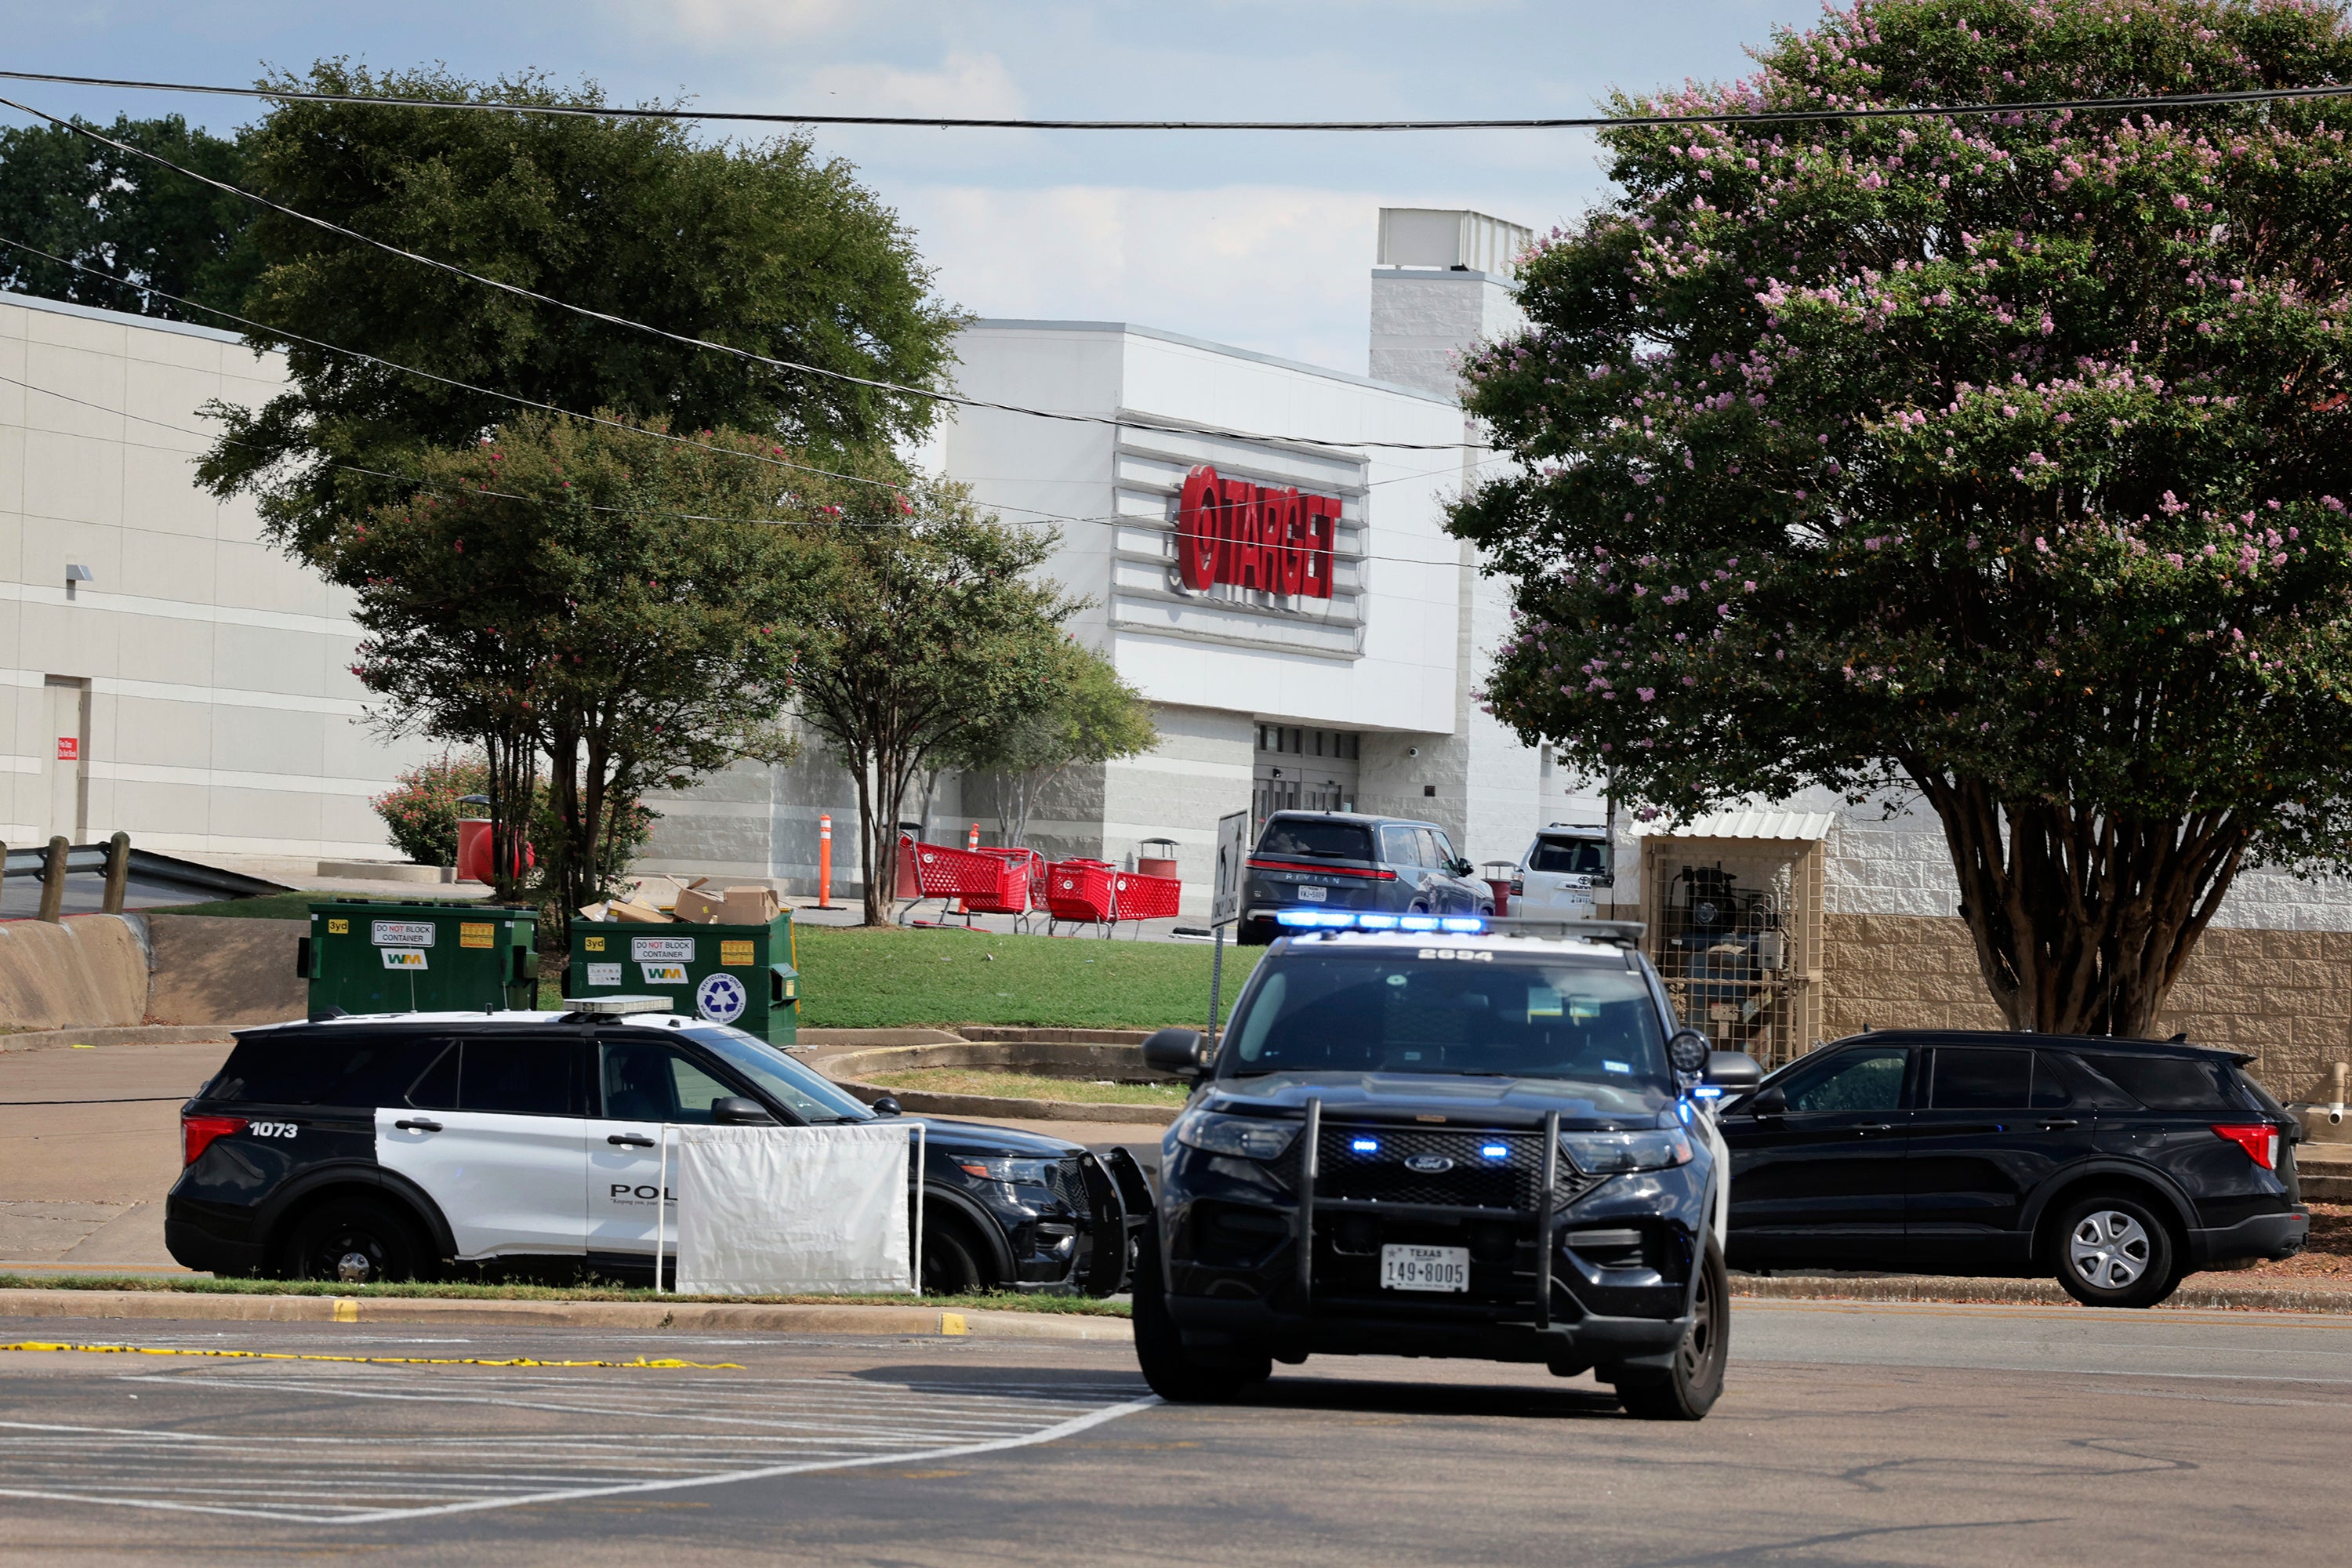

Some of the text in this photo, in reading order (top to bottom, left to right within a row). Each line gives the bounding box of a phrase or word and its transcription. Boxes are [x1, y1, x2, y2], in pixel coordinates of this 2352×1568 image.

[1220, 478, 1342, 599] TARGET
[1285, 873, 1341, 884] RIVIAN
[329, 921, 348, 931] 3yd
[586, 939, 604, 949] 3yd
[387, 953, 423, 964] WM
[1417, 948, 1494, 962] 2694
[648, 968, 682, 979] WM
[701, 974, 742, 991] RECYCLING ONLY
[249, 1121, 298, 1138] 1073
[610, 1184, 678, 1201] POL
[1409, 1248, 1443, 1258] TEXAS
